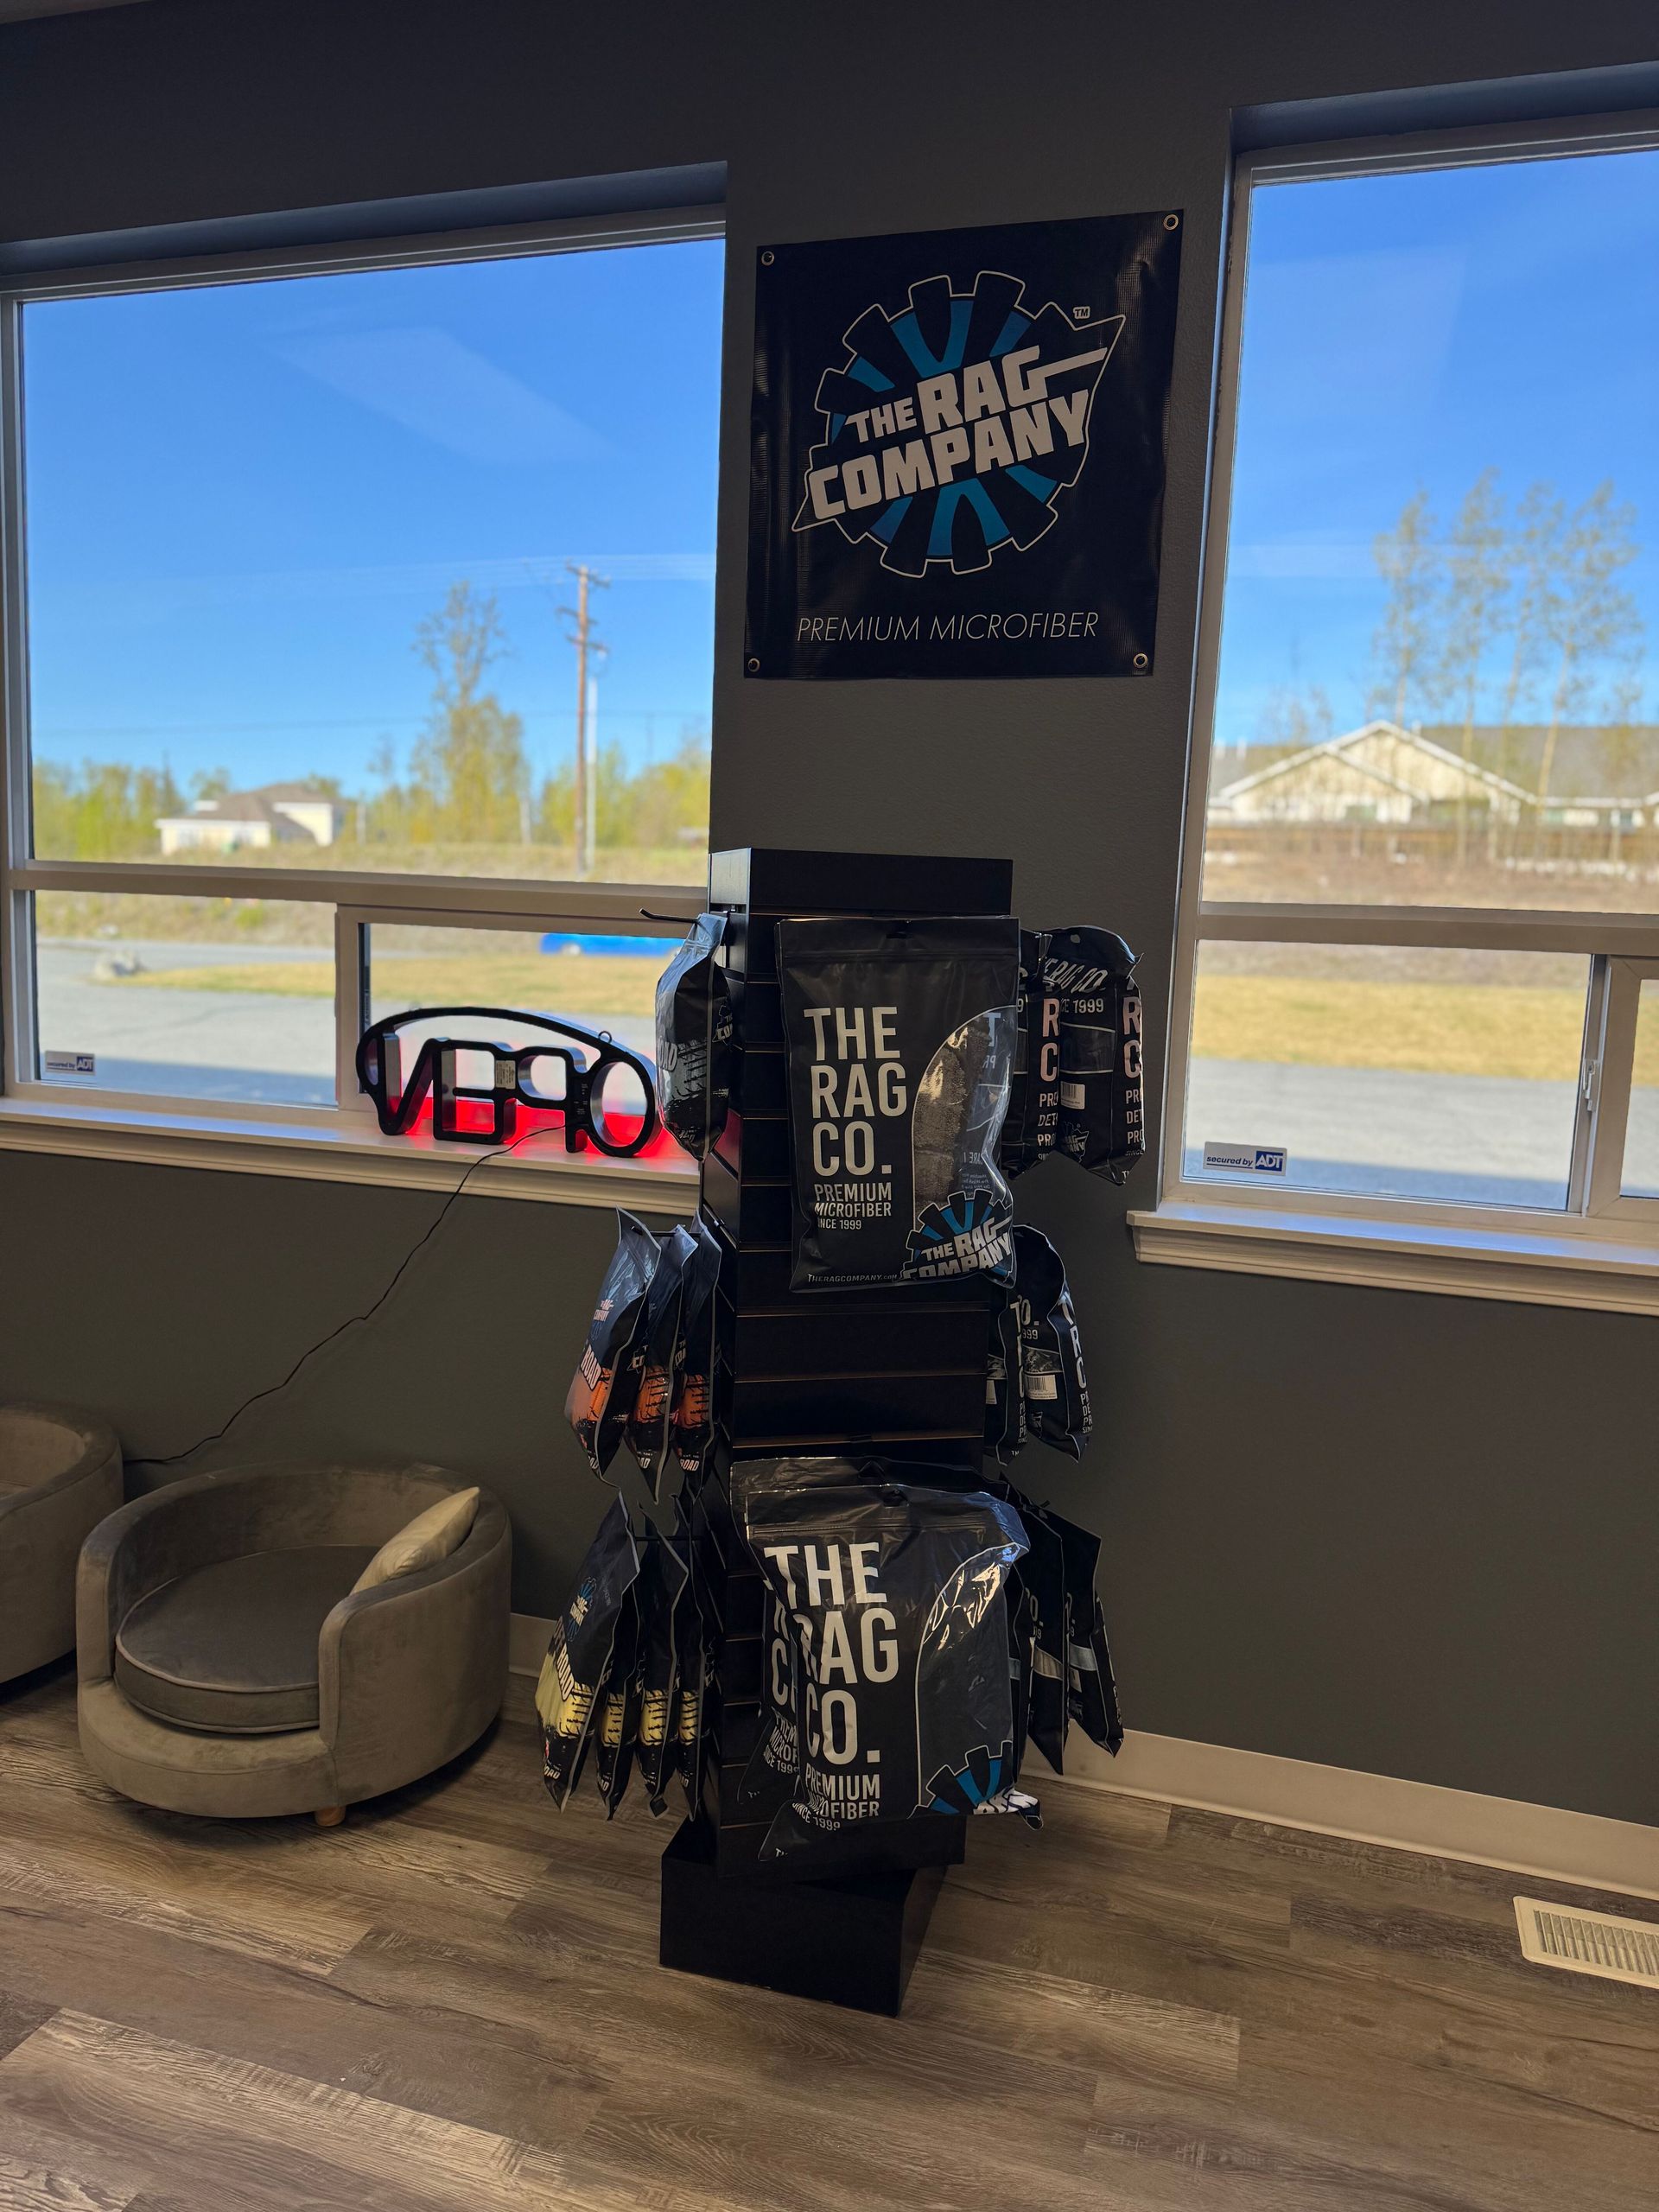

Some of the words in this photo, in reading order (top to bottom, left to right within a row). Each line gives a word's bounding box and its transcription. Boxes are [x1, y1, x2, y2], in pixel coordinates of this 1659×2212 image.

[1073, 307, 1090, 319] TM
[844, 397, 917, 443] THE
[917, 346, 1108, 433] RAG
[809, 390, 1090, 519] COMPANY
[798, 615, 919, 642] PREMIUM
[930, 611, 1099, 640] MICROFIBER
[1072, 997, 1104, 1014] 1999
[804, 1006, 900, 1061] THE
[77, 1057, 93, 1070] ADT
[810, 1063, 907, 1118] RAG
[813, 1121, 893, 1177] CO.
[1206, 1156, 1241, 1166] secured
[1243, 1158, 1253, 1167] by
[1255, 1154, 1283, 1169] ADT
[814, 1181, 893, 1203] PREMIUM
[814, 1202, 893, 1218] MICROFIBER
[817, 1217, 836, 1229] INCE
[839, 1219, 862, 1230] 1999
[921, 1242, 954, 1262] THE
[954, 1215, 1012, 1257] RAG
[580, 1344, 602, 1390] ROAD
[679, 1459, 700, 1471] ROAD
[763, 1541, 888, 1610] THE
[556, 1642, 575, 1700] ROAD
[804, 1682, 880, 1765] CO.
[769, 1726, 798, 1764] MICROF
[544, 1766, 561, 1780] OAD
[804, 1762, 881, 1802] PREMIUM
